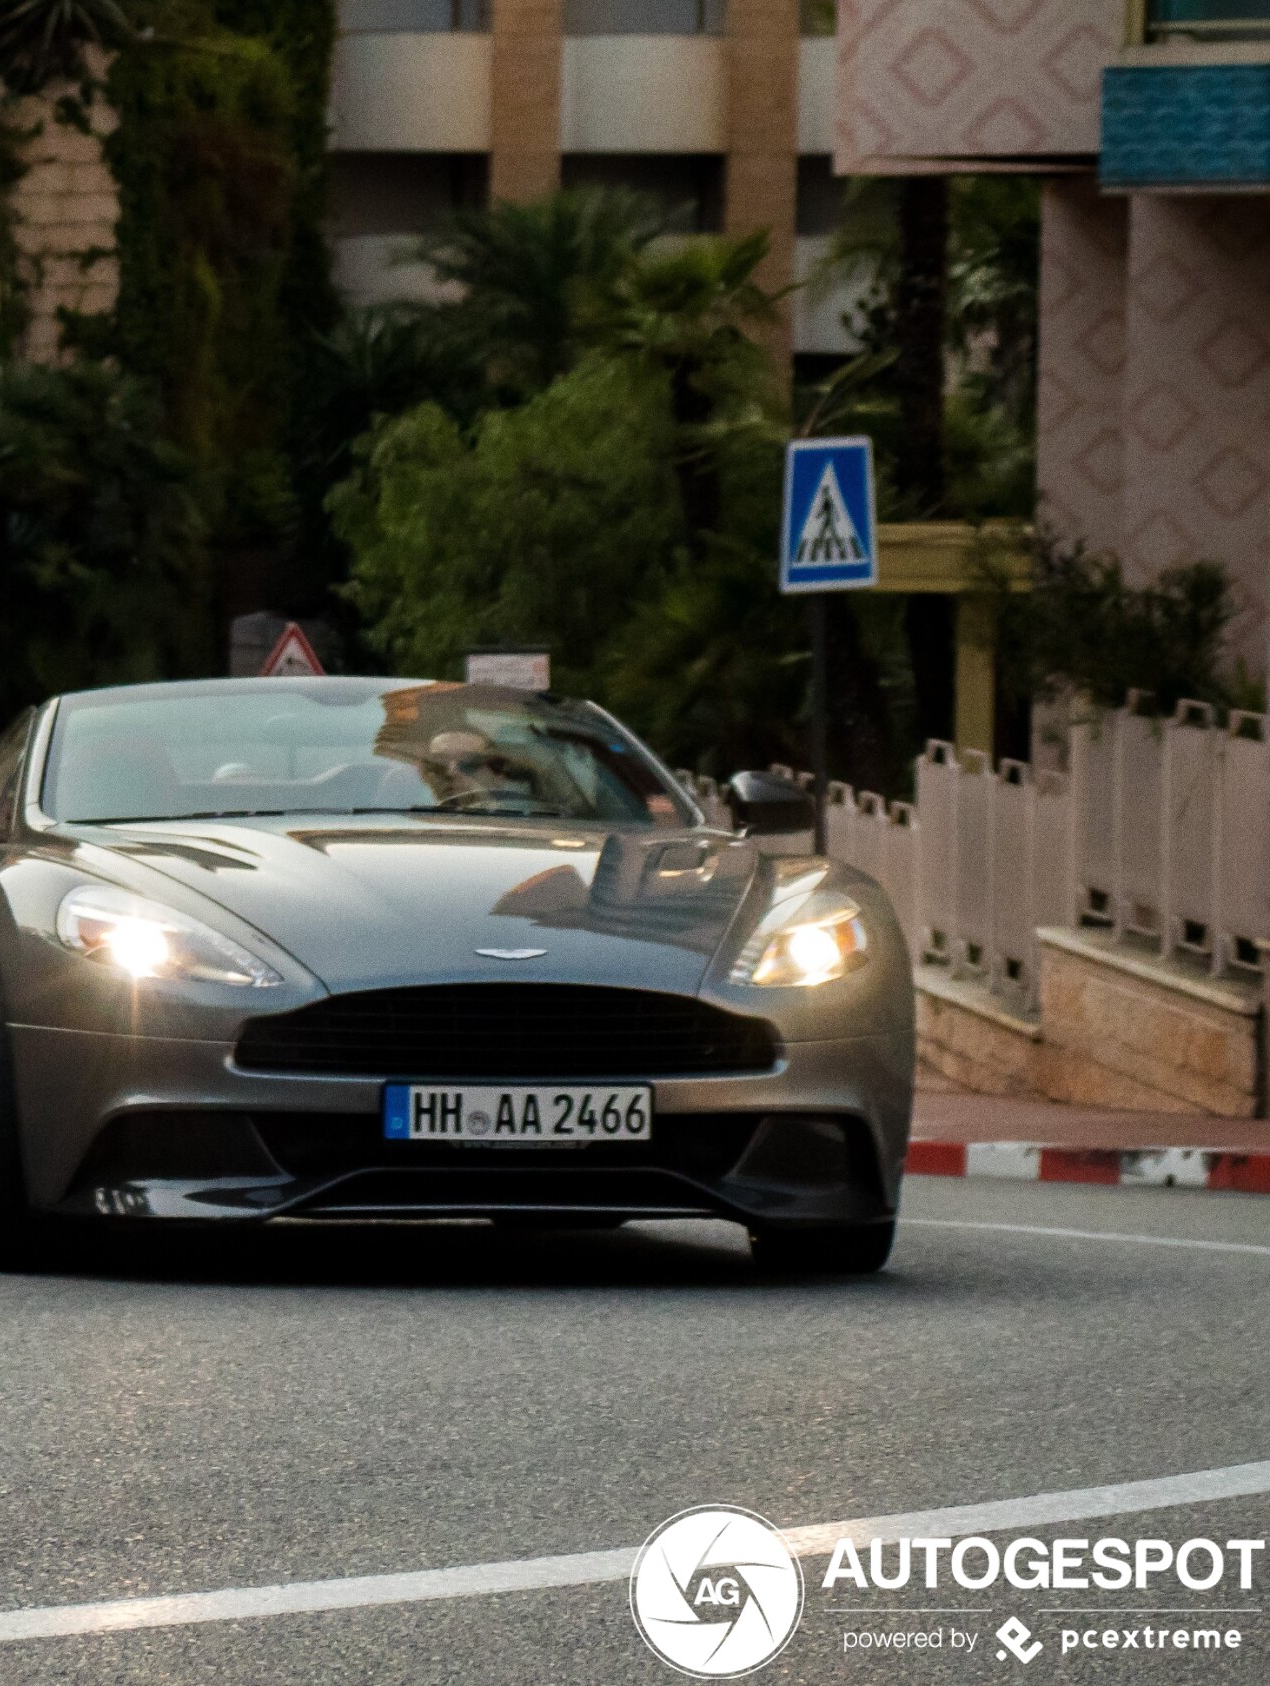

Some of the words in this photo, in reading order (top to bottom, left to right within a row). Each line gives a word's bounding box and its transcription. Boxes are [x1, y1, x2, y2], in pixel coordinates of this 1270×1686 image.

[414, 1092, 463, 1134] HH
[494, 1092, 543, 1134] AA
[552, 1092, 647, 1135] 2466
